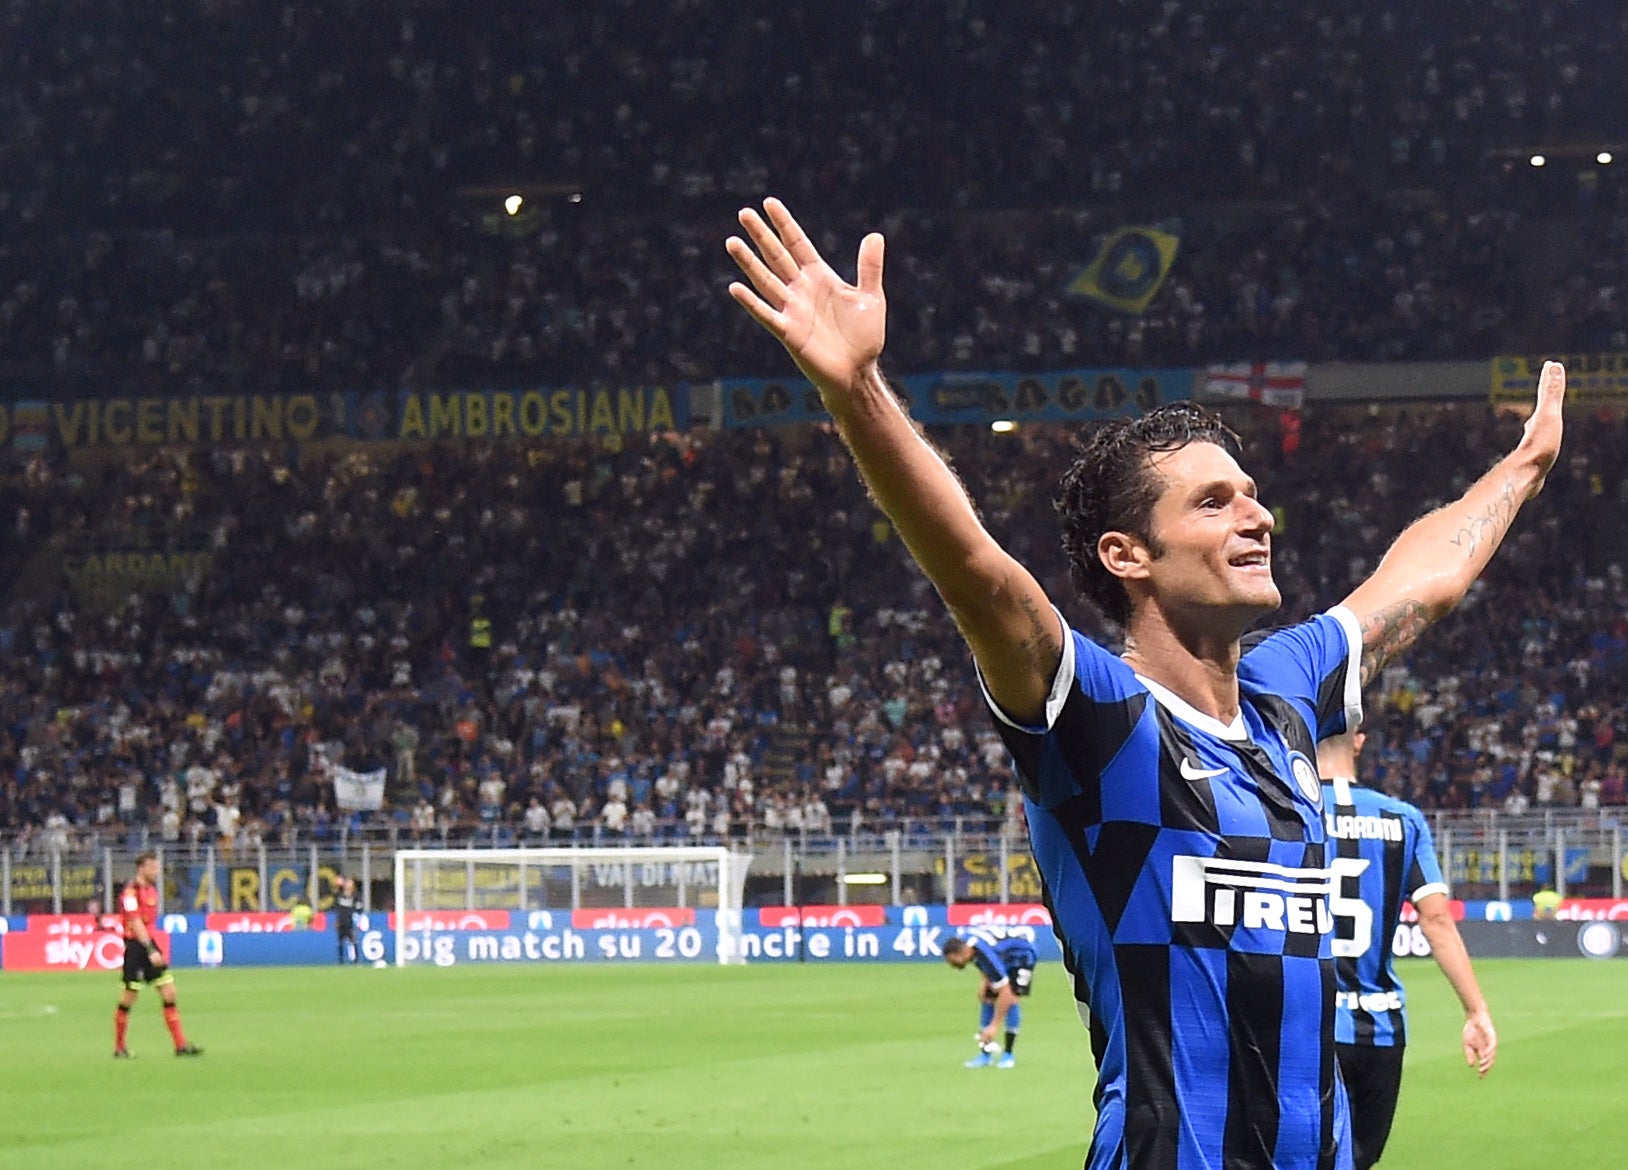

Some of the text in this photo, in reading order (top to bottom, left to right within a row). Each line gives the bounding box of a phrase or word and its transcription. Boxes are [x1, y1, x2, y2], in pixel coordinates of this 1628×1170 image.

[54, 394, 320, 445] VICENTINO
[401, 387, 674, 438] AMBROSIANA
[1329, 857, 1374, 958] 5
[362, 930, 385, 961] 6
[402, 927, 455, 967] big
[468, 927, 585, 961] match
[598, 932, 641, 958] su
[654, 927, 702, 958] 20
[844, 925, 880, 957] in
[892, 925, 943, 957] 4K
